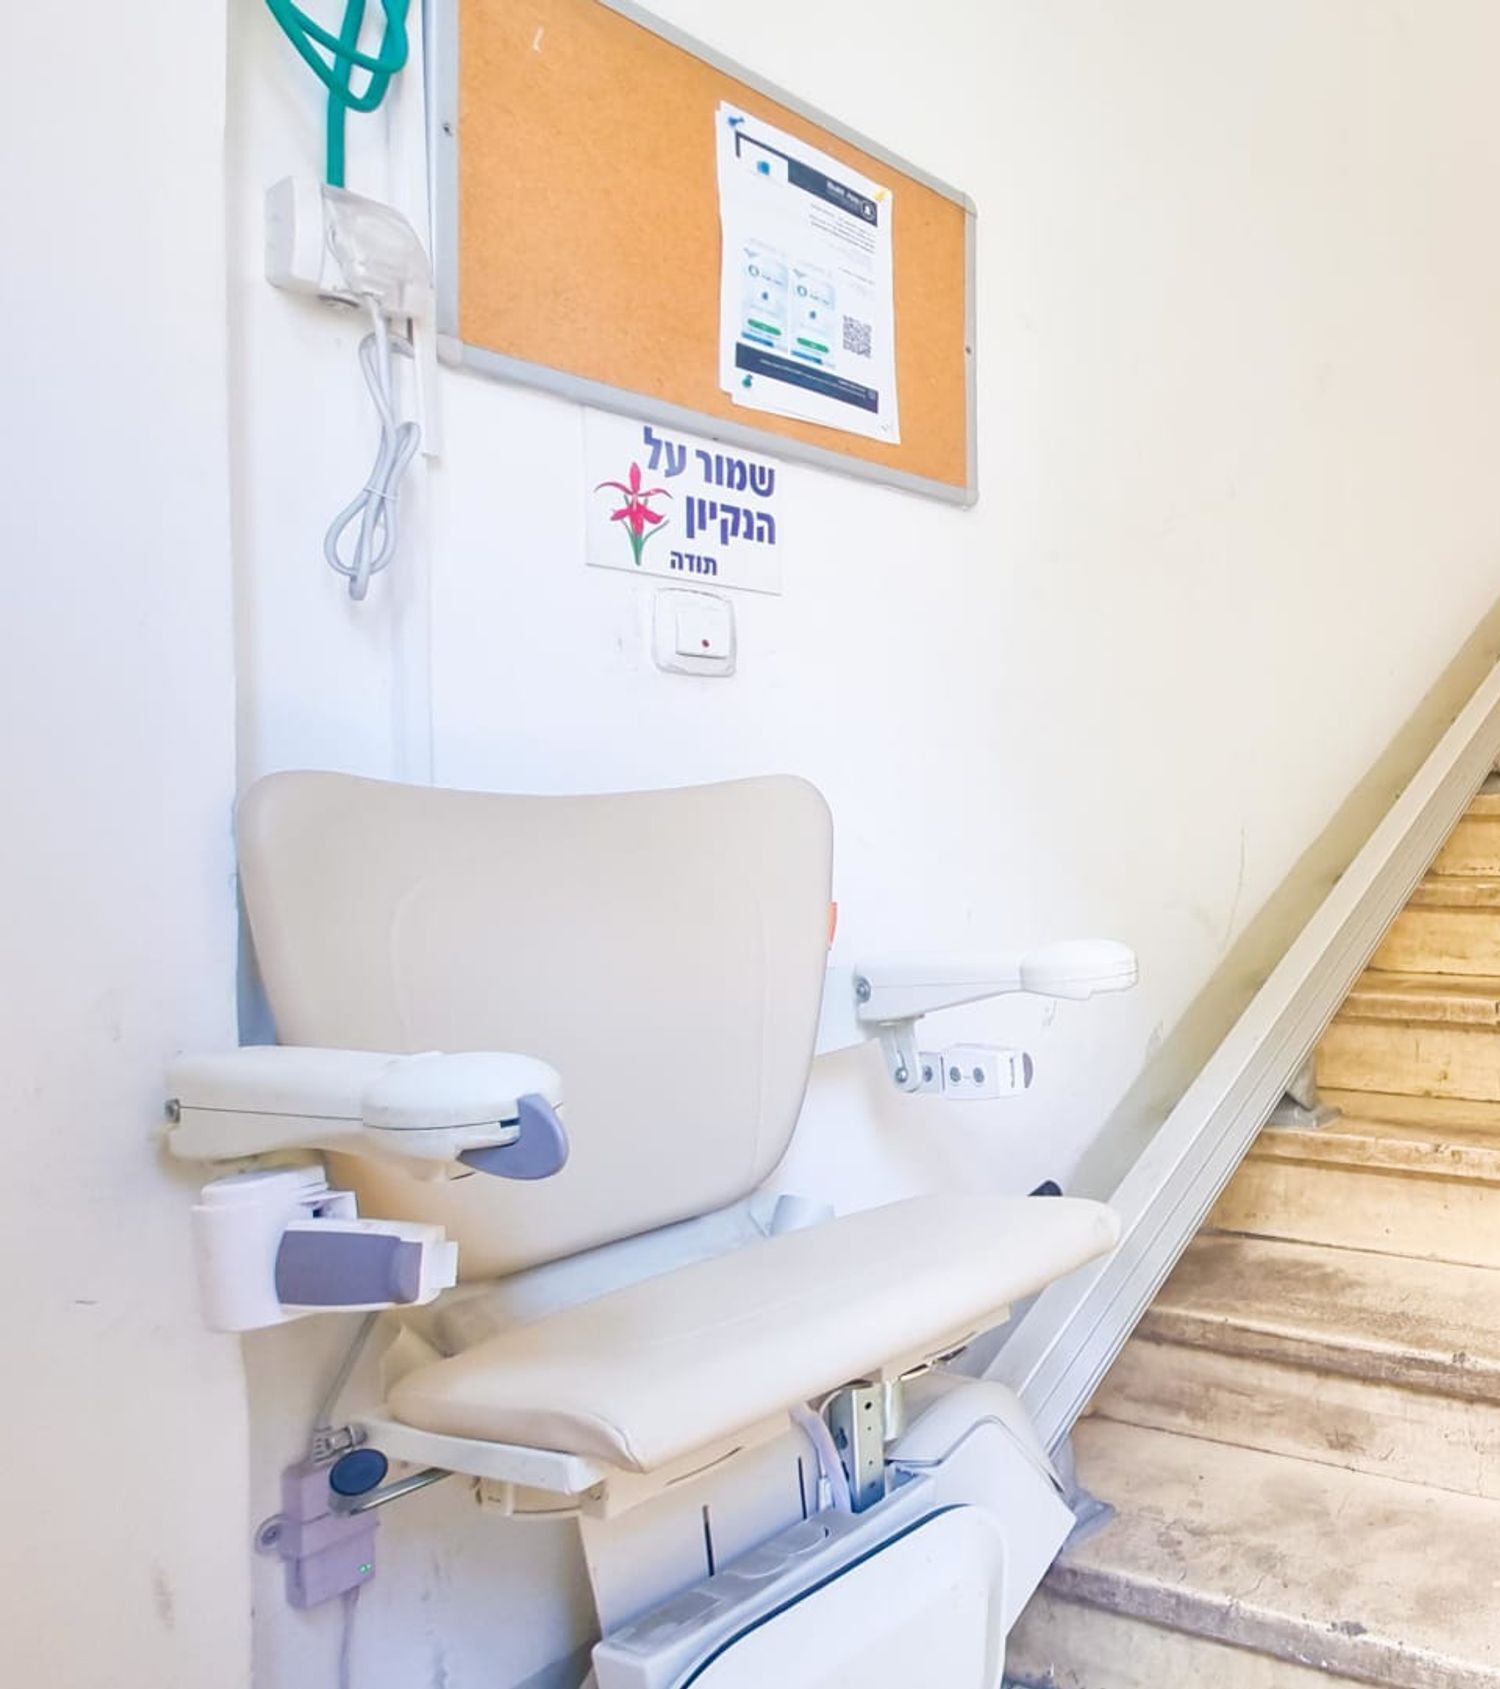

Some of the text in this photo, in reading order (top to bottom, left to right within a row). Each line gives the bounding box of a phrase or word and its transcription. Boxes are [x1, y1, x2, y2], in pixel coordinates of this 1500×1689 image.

[643, 425, 775, 498] שמור על
[685, 495, 776, 546] הנקיון
[669, 550, 718, 576] תודה
